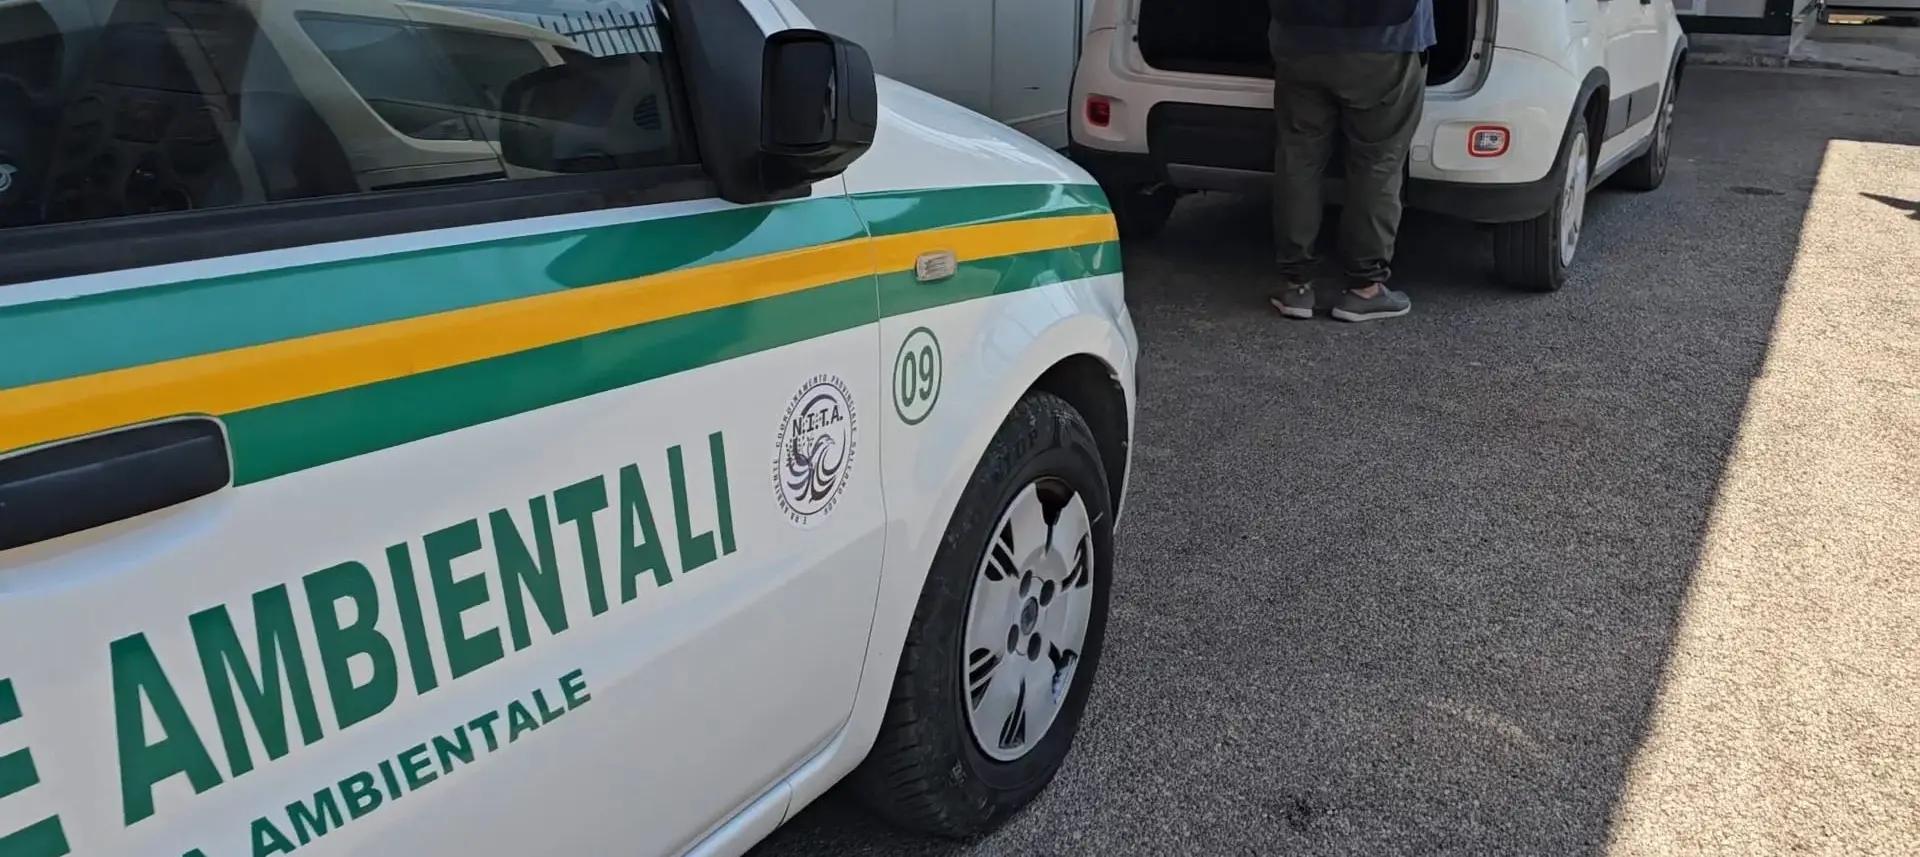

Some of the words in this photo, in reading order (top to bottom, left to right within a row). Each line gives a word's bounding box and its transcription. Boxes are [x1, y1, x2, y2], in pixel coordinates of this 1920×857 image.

[792, 405, 843, 437] N.I.T.A.
[902, 345, 934, 407] 09
[110, 431, 737, 828] AMBIENTALI
[250, 668, 592, 857] AMBIENTALE
